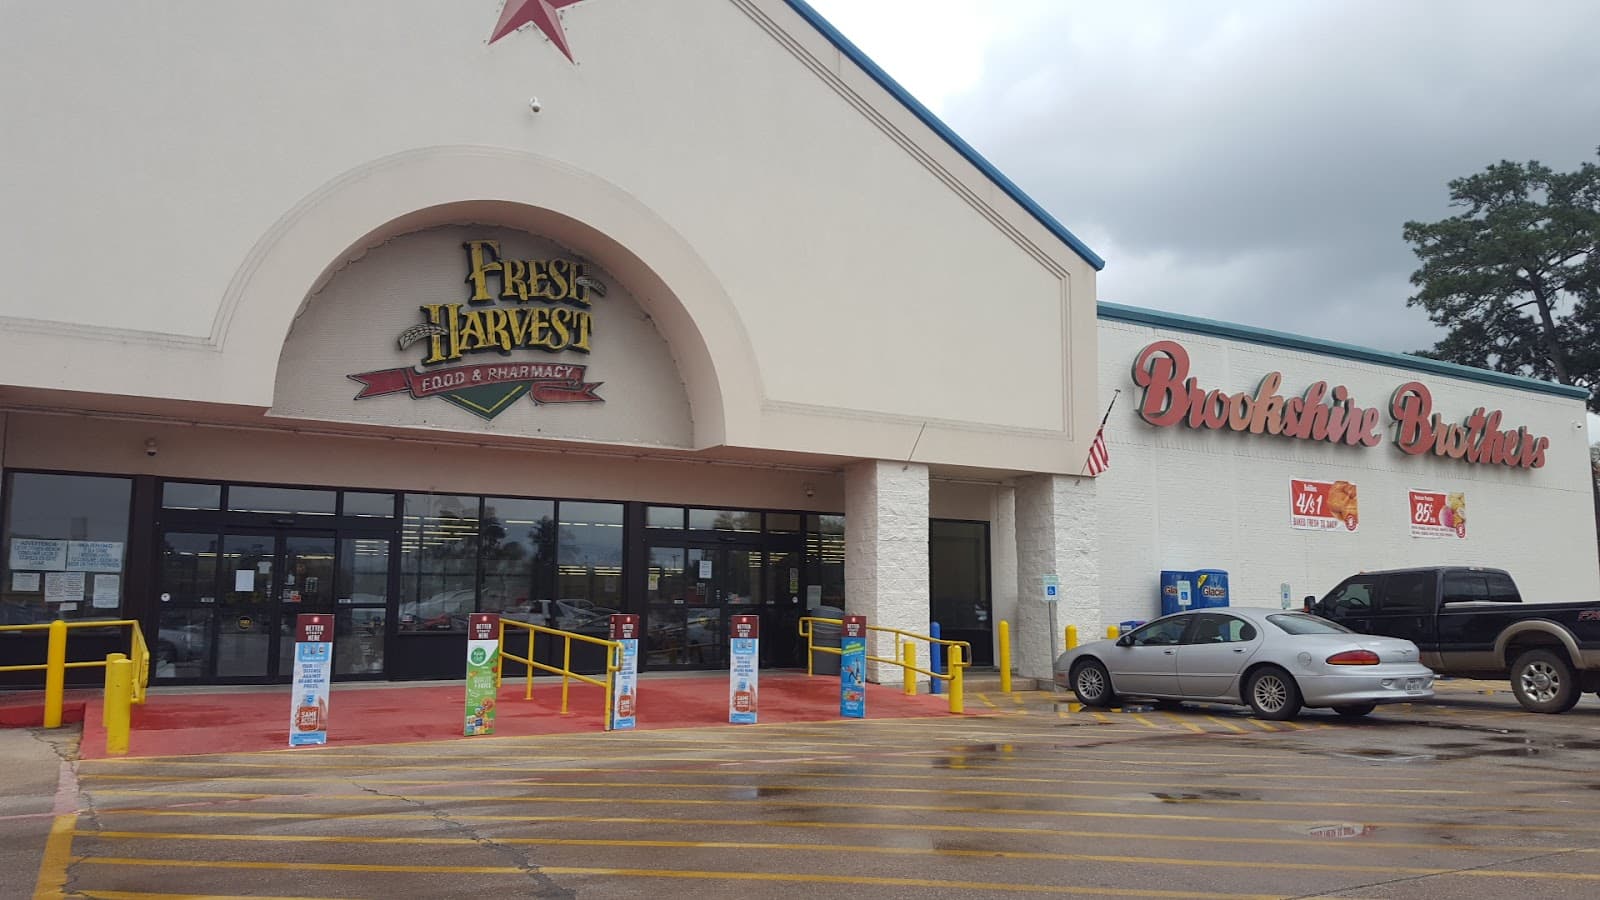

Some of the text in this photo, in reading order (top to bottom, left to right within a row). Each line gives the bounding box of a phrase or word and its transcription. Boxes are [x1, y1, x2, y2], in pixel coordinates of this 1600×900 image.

[463, 239, 593, 305] FRESH
[421, 303, 593, 365] HARVEST
[421, 365, 575, 392] FOOD & PHARMACY
[1131, 340, 1550, 469] Brookshire Brothers
[1296, 493, 1323, 515] 4/$1
